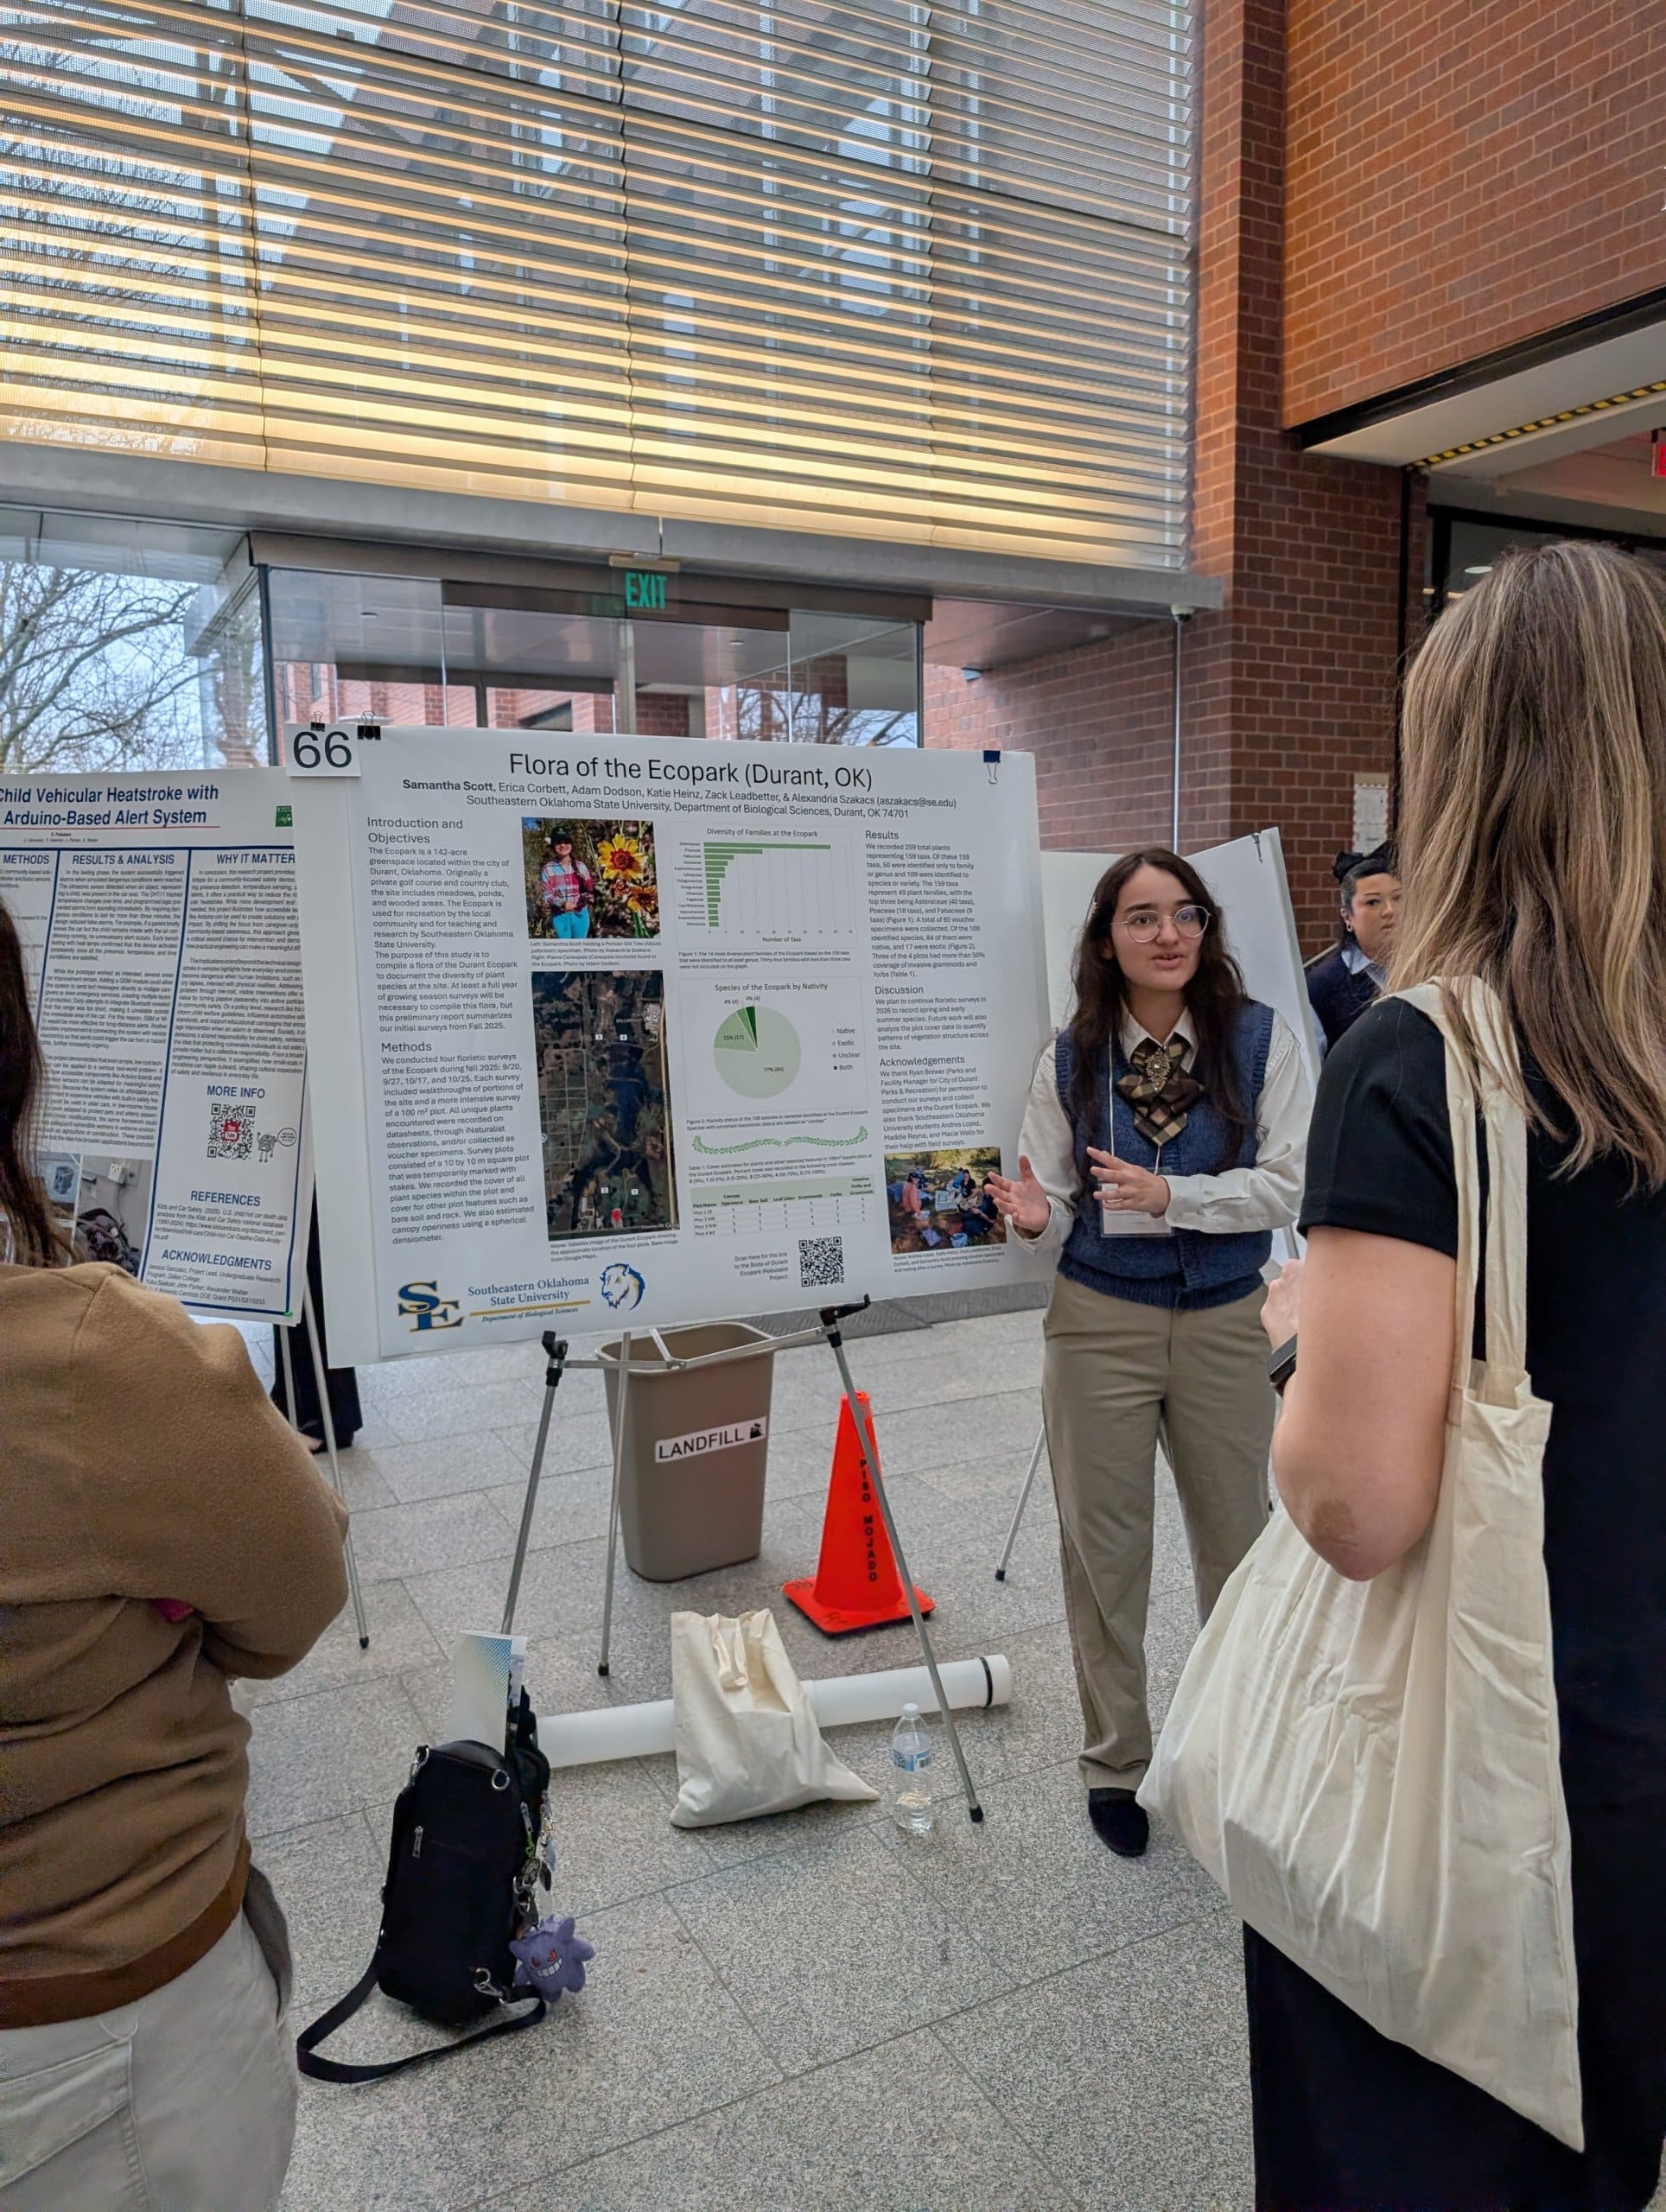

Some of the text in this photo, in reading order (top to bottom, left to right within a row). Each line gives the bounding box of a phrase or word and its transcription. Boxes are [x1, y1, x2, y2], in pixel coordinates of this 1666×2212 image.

[626, 572, 667, 609] EXIT
[293, 731, 353, 768] 66
[510, 753, 872, 792] Flora of the Ecopark (Durant, OK)
[36, 787, 103, 803] Vehicular
[106, 785, 182, 803] Heatstroke
[187, 784, 219, 800] with
[402, 779, 957, 809] Samantha Scott, Erica Corbett, Adam Dodson, Katie Heinz, Zack Leadbetter, & Alexandria Szakacs (aszakacs@se.edu)
[466, 794, 908, 818] Southeastern Oklahoma State University, Department of Biological Sciences, Durant, OK 74701
[3, 809, 207, 827] Arduino-Based Alert System
[367, 817, 463, 829] Introduction and
[367, 832, 430, 845] Objectives
[707, 827, 736, 836] Diversity
[792, 830, 818, 838] Ecopark
[864, 830, 899, 840] Results
[367, 846, 384, 855] The
[384, 847, 417, 856] Ecopark
[426, 849, 432, 857] a
[3, 854, 50, 864] METHODS
[72, 854, 175, 865] RESULTS & ANALYSIS
[216, 854, 238, 864] WHY
[240, 853, 250, 863] IT
[486, 858, 500, 868] city
[370, 868, 399, 876] Durant,
[401, 868, 443, 877] Oklahoma.
[446, 868, 483, 878] Originally
[370, 878, 397, 887] private
[398, 878, 414, 887] golf
[460, 880, 489, 888] country
[490, 879, 510, 888] club,
[436, 889, 477, 898] meadows,
[373, 940, 436, 950] State University.
[714, 983, 741, 993] Species
[764, 982, 792, 991] Ecopark
[792, 982, 801, 991] by
[874, 983, 924, 996] Discussion
[381, 1041, 432, 1052] Methods
[395, 1055, 438, 1065] conducted
[456, 1053, 486, 1062] floristic
[879, 1055, 965, 1067] Acknowledgements
[405, 1065, 439, 1075] Ecopark
[439, 1065, 465, 1074] during
[465, 1064, 479, 1072] fall
[207, 1084, 265, 1099] MORE INFO
[190, 1190, 261, 1206] REFERENCES
[162, 1249, 272, 1270] ACKNOWLEDGMENTS
[467, 1277, 589, 1296] Southeastern Oklahoma
[490, 1289, 569, 1306] State University
[658, 1427, 744, 1459] LANDFILL
[860, 1459, 870, 1502] PISO
[863, 1516, 878, 1582] MOJADO
